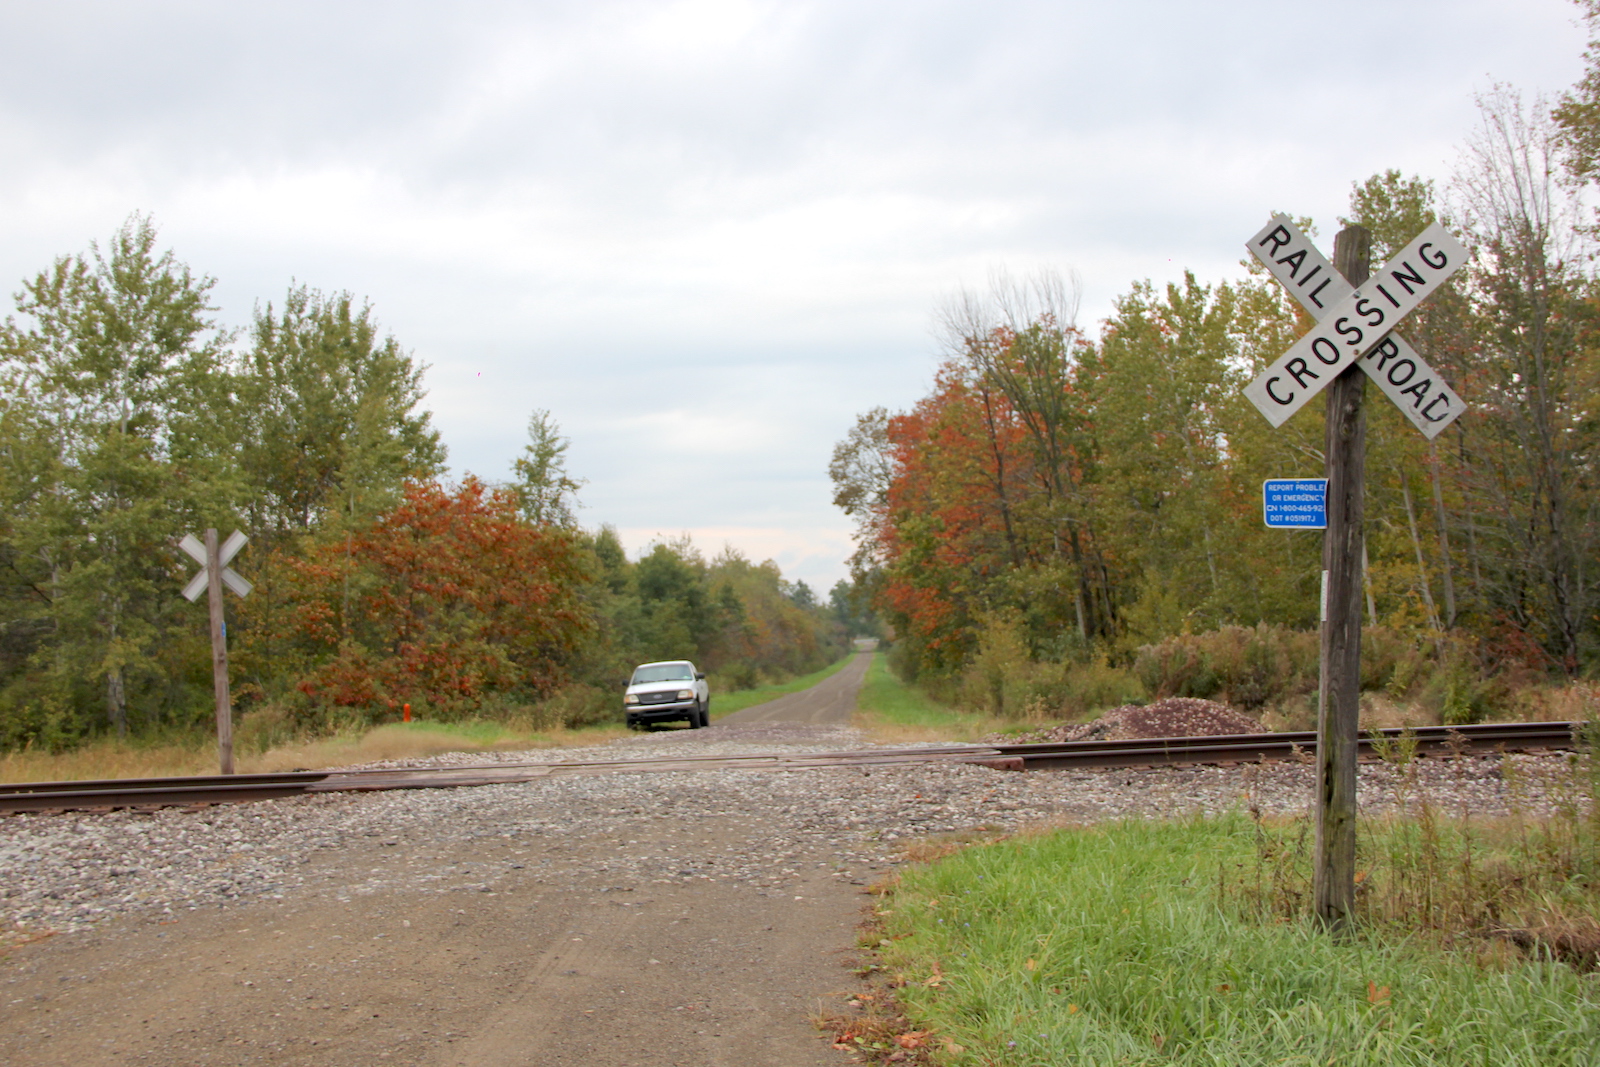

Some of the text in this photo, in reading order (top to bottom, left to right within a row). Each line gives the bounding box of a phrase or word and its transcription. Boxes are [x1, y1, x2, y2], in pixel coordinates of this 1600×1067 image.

[1259, 224, 1449, 423] RAIL ROAD
[1265, 242, 1447, 405] CROSSING
